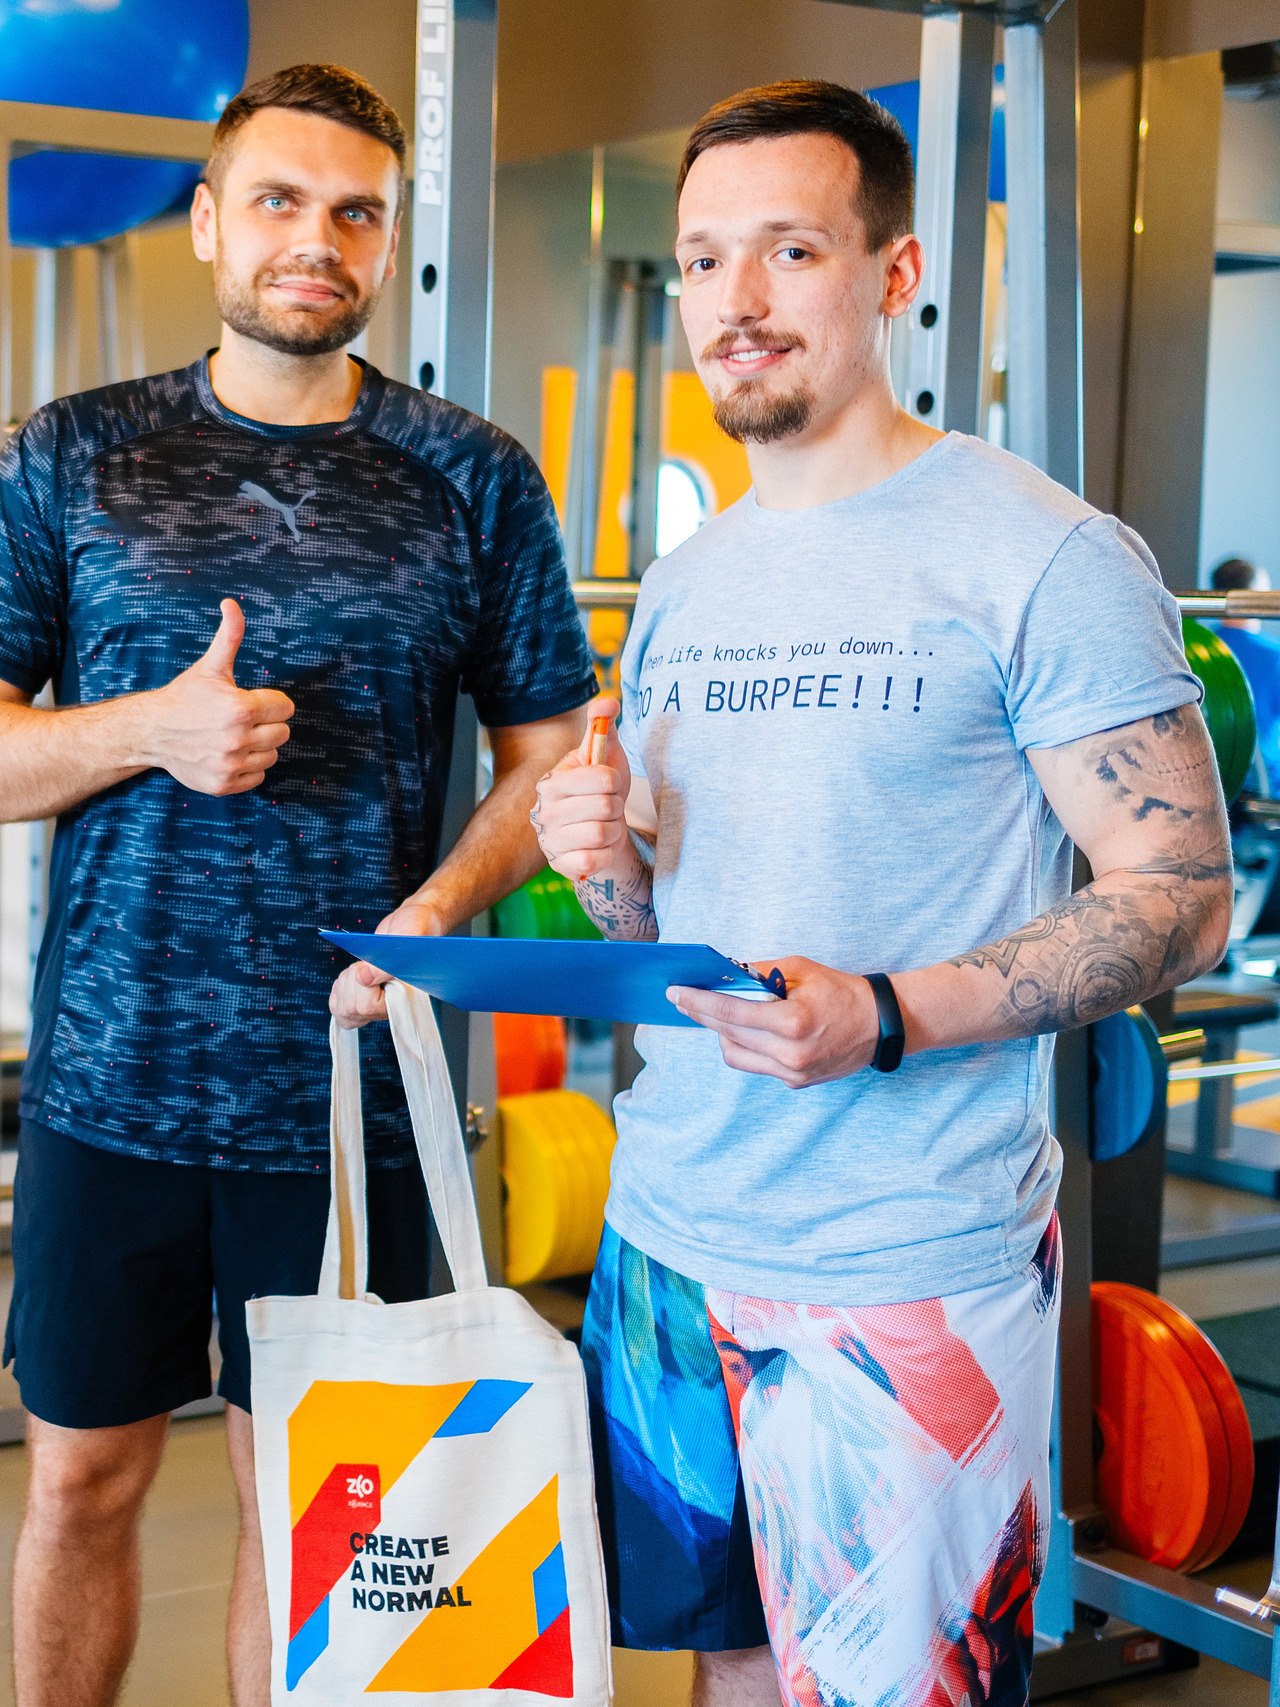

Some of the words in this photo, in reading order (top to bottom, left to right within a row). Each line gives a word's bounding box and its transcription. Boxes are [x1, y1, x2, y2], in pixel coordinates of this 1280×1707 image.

[421, 0, 447, 53] LI
[419, 68, 446, 206] PROF
[667, 645, 703, 664] life
[713, 643, 778, 662] knocks
[787, 640, 826, 663] you
[839, 637, 934, 656] down...
[663, 680, 681, 713] A
[705, 674, 924, 714] BURPEE!!!
[349, 1532, 450, 1559] CREATE
[350, 1560, 366, 1582] A
[371, 1561, 435, 1586] NEW
[352, 1586, 472, 1613] NORMAL
